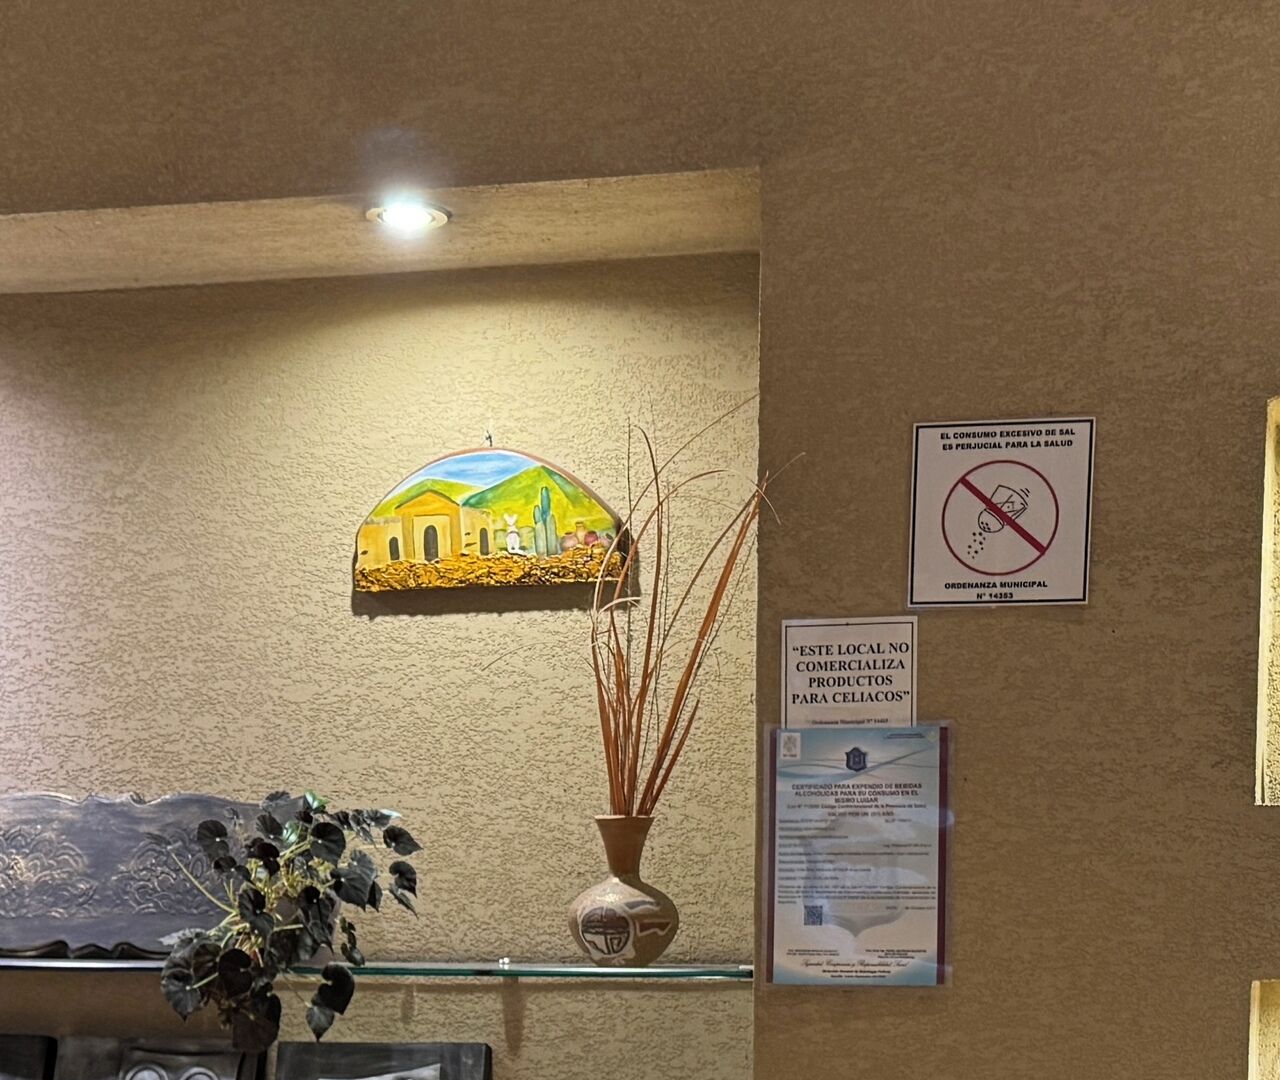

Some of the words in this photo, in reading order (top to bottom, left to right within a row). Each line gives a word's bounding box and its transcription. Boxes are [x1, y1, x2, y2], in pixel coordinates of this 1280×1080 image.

[940, 432, 951, 440] EL
[953, 431, 997, 440] CONSUMO
[999, 429, 1043, 438] EXCESIVO
[1059, 428, 1076, 436] SAL
[942, 443, 954, 451] ES
[1005, 441, 1028, 449] PARA
[1030, 440, 1042, 448] LA
[1044, 439, 1073, 448] SALUD
[944, 582, 998, 590] ORDENANZA
[999, 580, 1048, 589] MUNICIPAL
[837, 643, 885, 655] LOCAL
[888, 641, 910, 654] NO
[796, 658, 905, 673] COMERCIALIZA
[808, 675, 893, 688] PRODUCTOS
[791, 693, 828, 705] PARA
